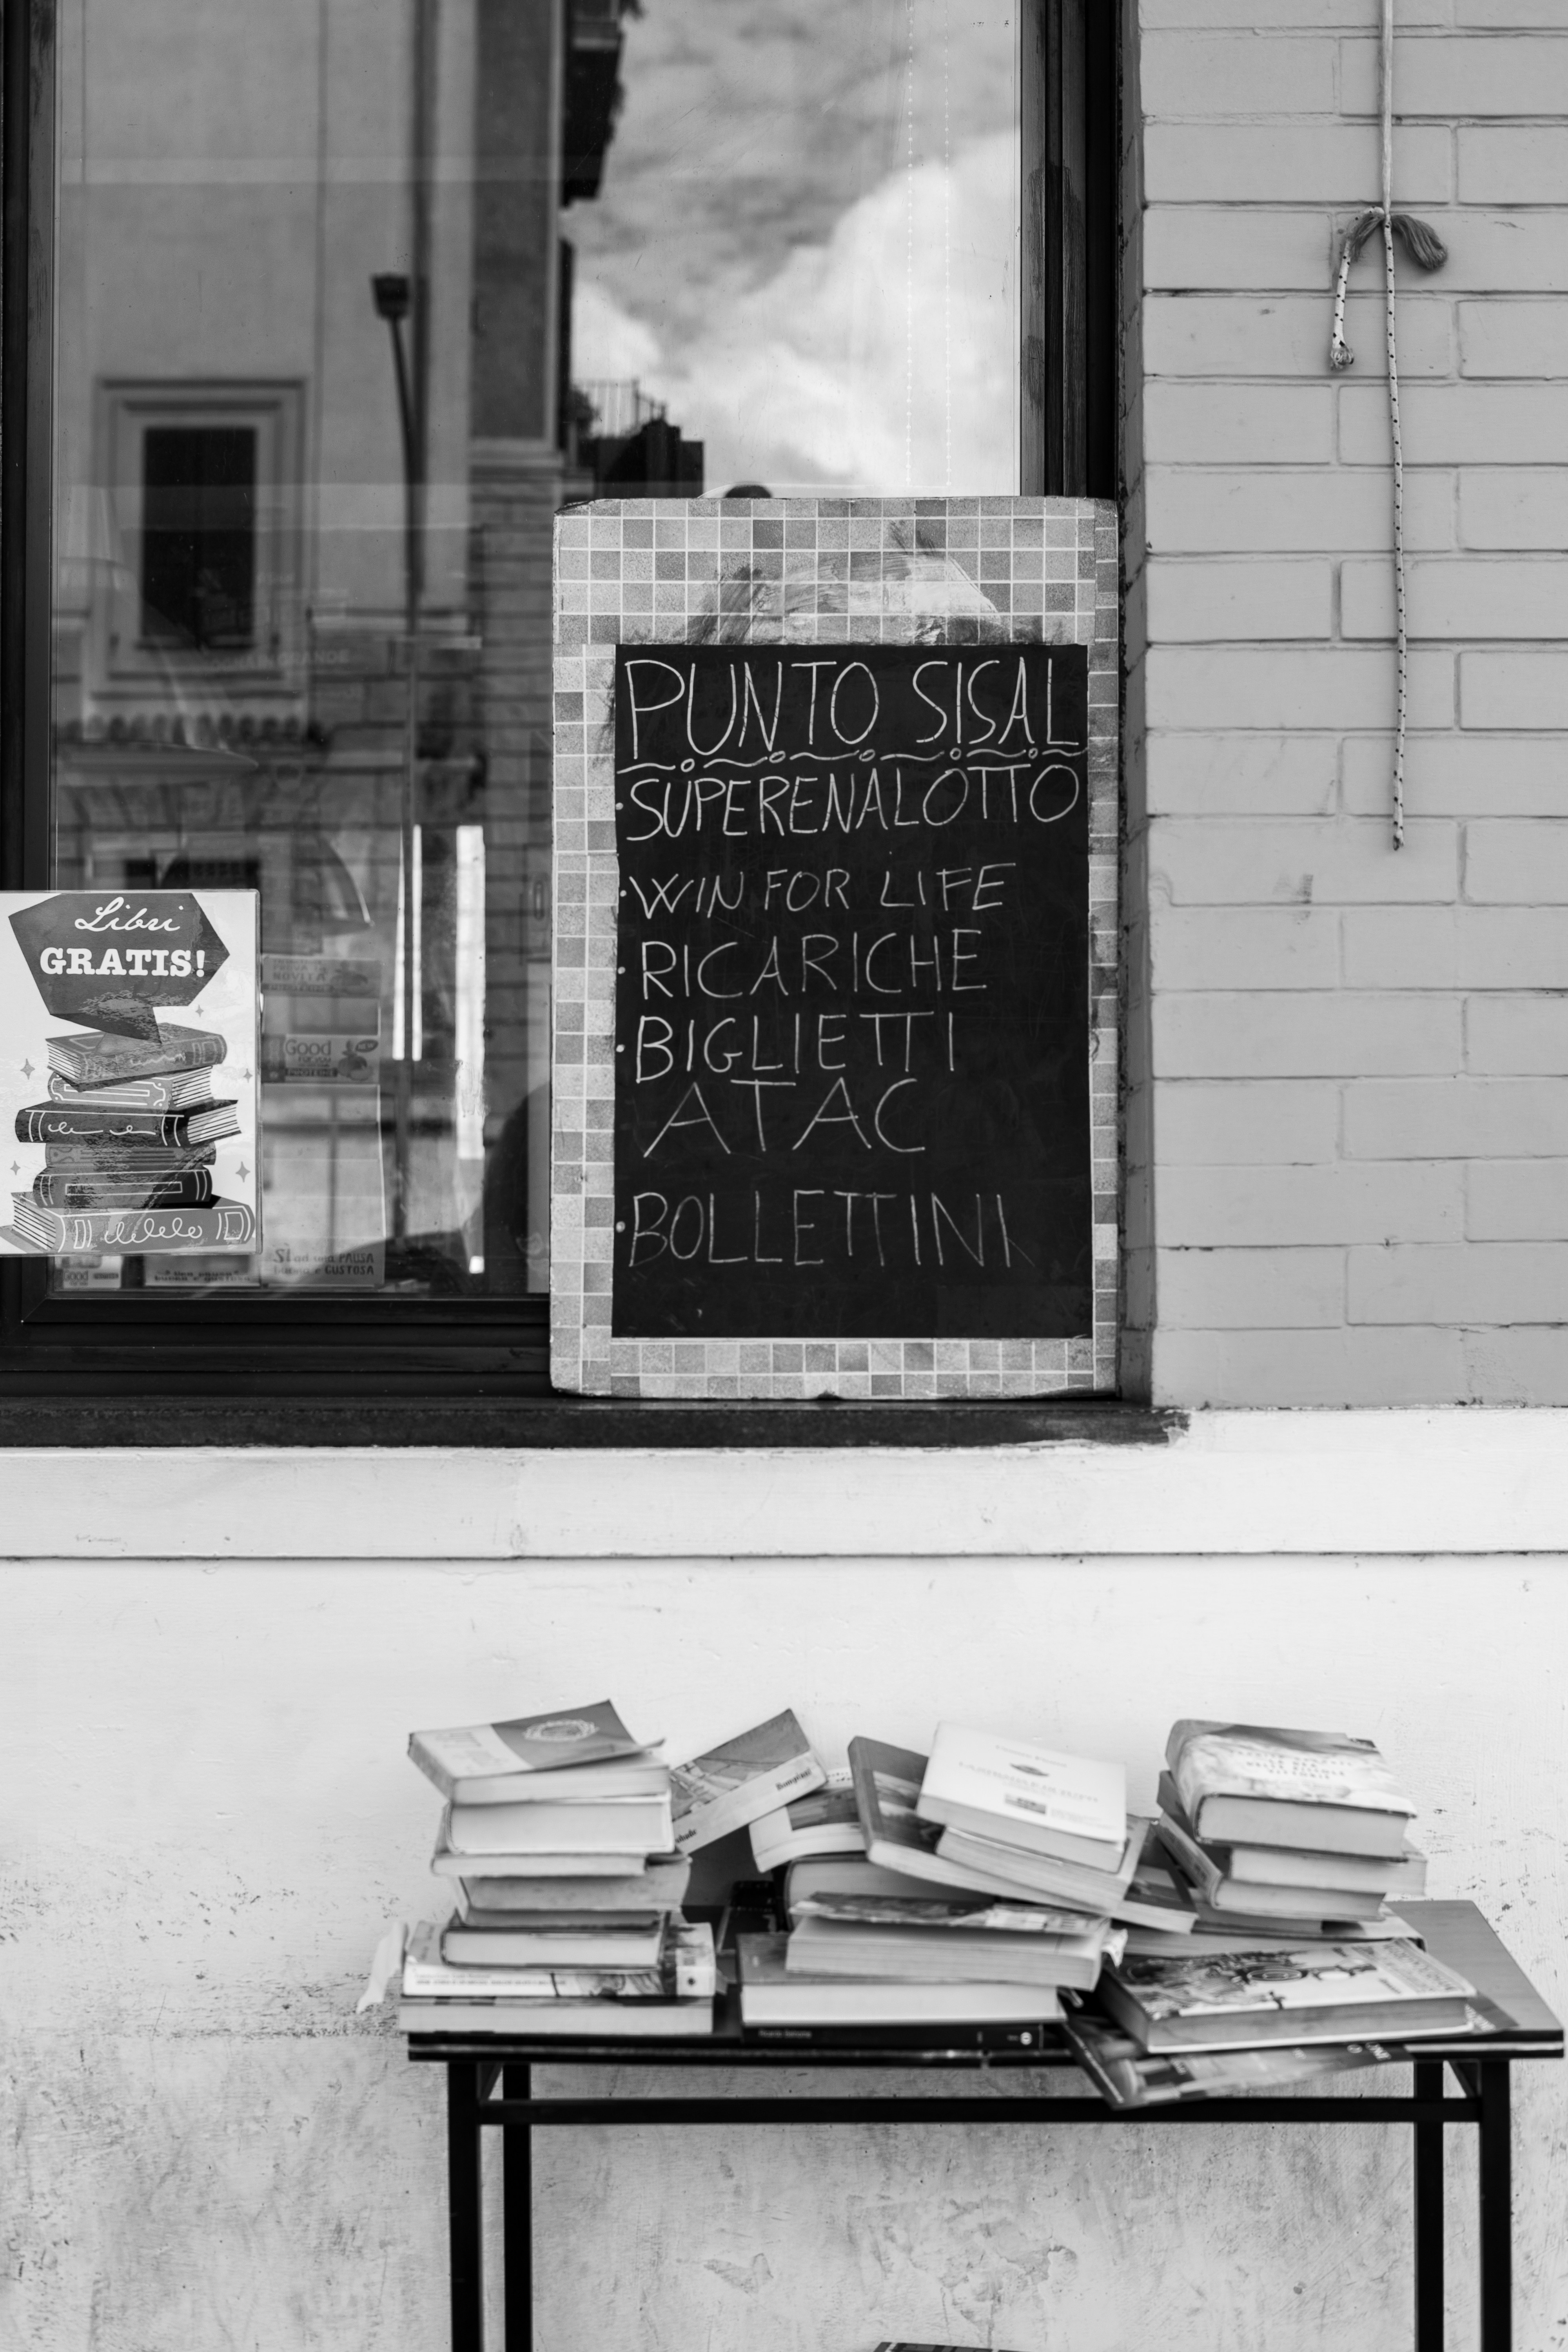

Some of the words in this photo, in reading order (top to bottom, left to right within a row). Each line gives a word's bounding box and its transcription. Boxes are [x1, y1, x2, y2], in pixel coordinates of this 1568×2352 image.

[624, 659, 880, 759] PUNTO
[912, 656, 1079, 746] SISAL
[626, 764, 1079, 841] SUPERENALOTTO
[74, 896, 184, 932] Libri
[628, 871, 744, 919] WIN
[764, 868, 850, 912] FOR
[880, 862, 1016, 911] LIFE
[40, 947, 205, 977] GRATIS!
[641, 928, 987, 1000] RICARICHE
[285, 1039, 331, 1055] Good
[635, 1011, 955, 1083] BIGLIETTI
[643, 1076, 926, 1158] ATAC
[339, 1253, 374, 1263] PAUSA
[628, 1189, 1011, 1268] BOLLETTINI
[325, 1265, 374, 1275] GUSTOSA
